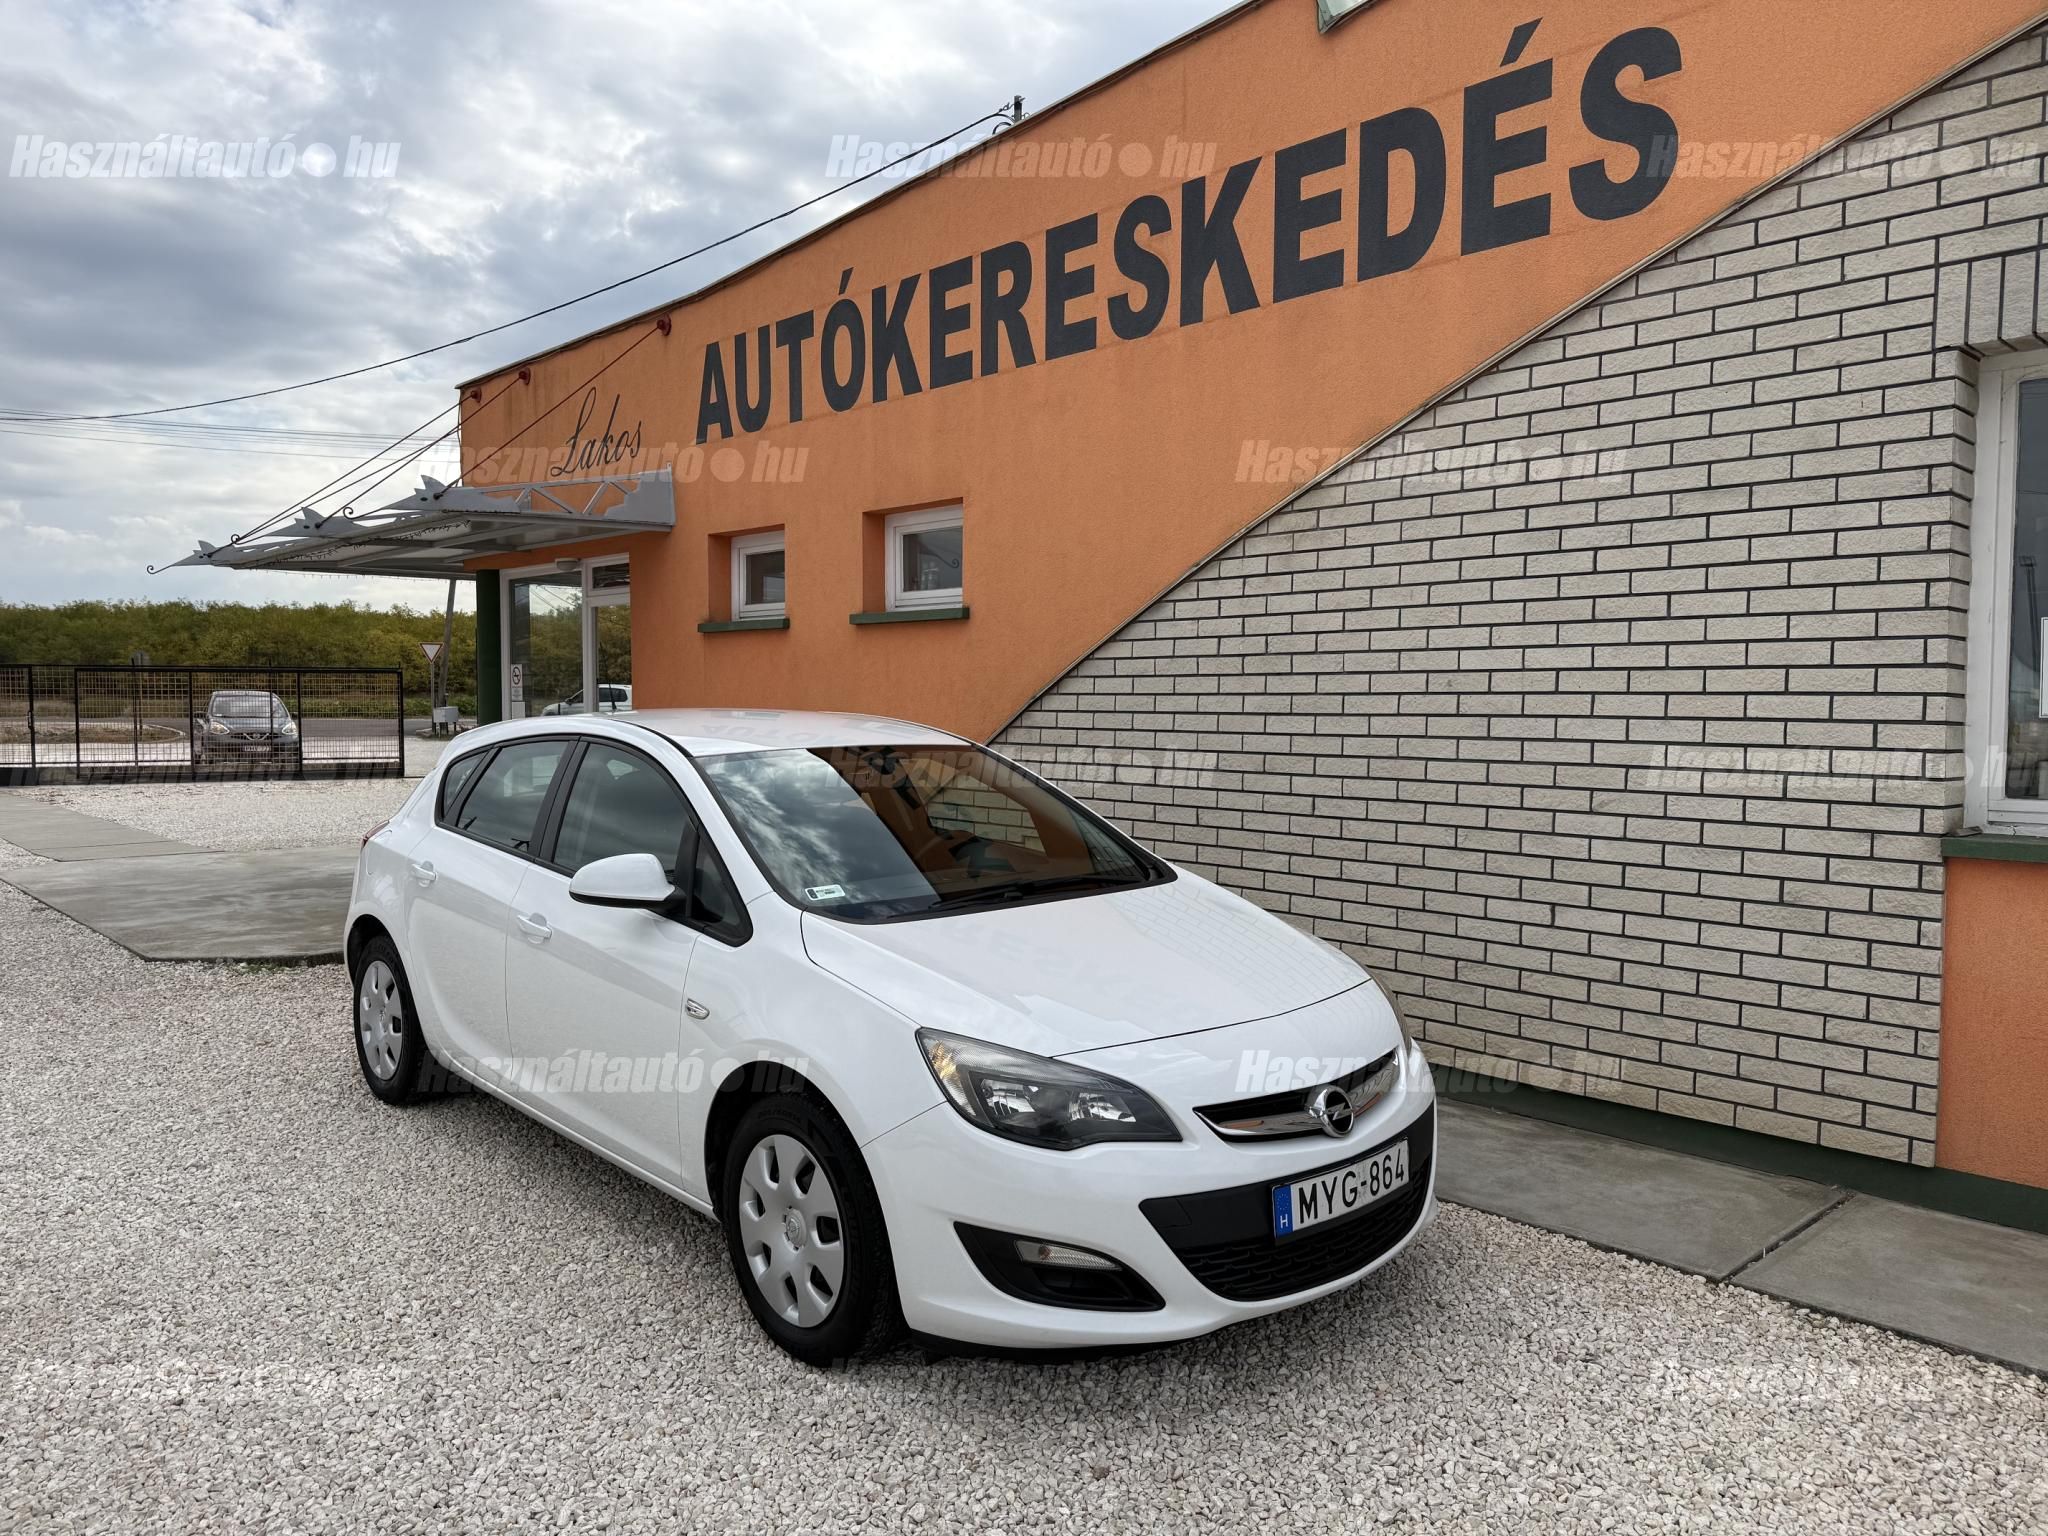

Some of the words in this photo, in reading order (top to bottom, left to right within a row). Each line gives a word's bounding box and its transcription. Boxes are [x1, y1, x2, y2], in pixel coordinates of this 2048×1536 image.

[696, 18, 1682, 444] AUTÓKERESKEDÉS
[550, 386, 642, 477] Lakos
[1298, 1149, 1405, 1224] MYG-864
